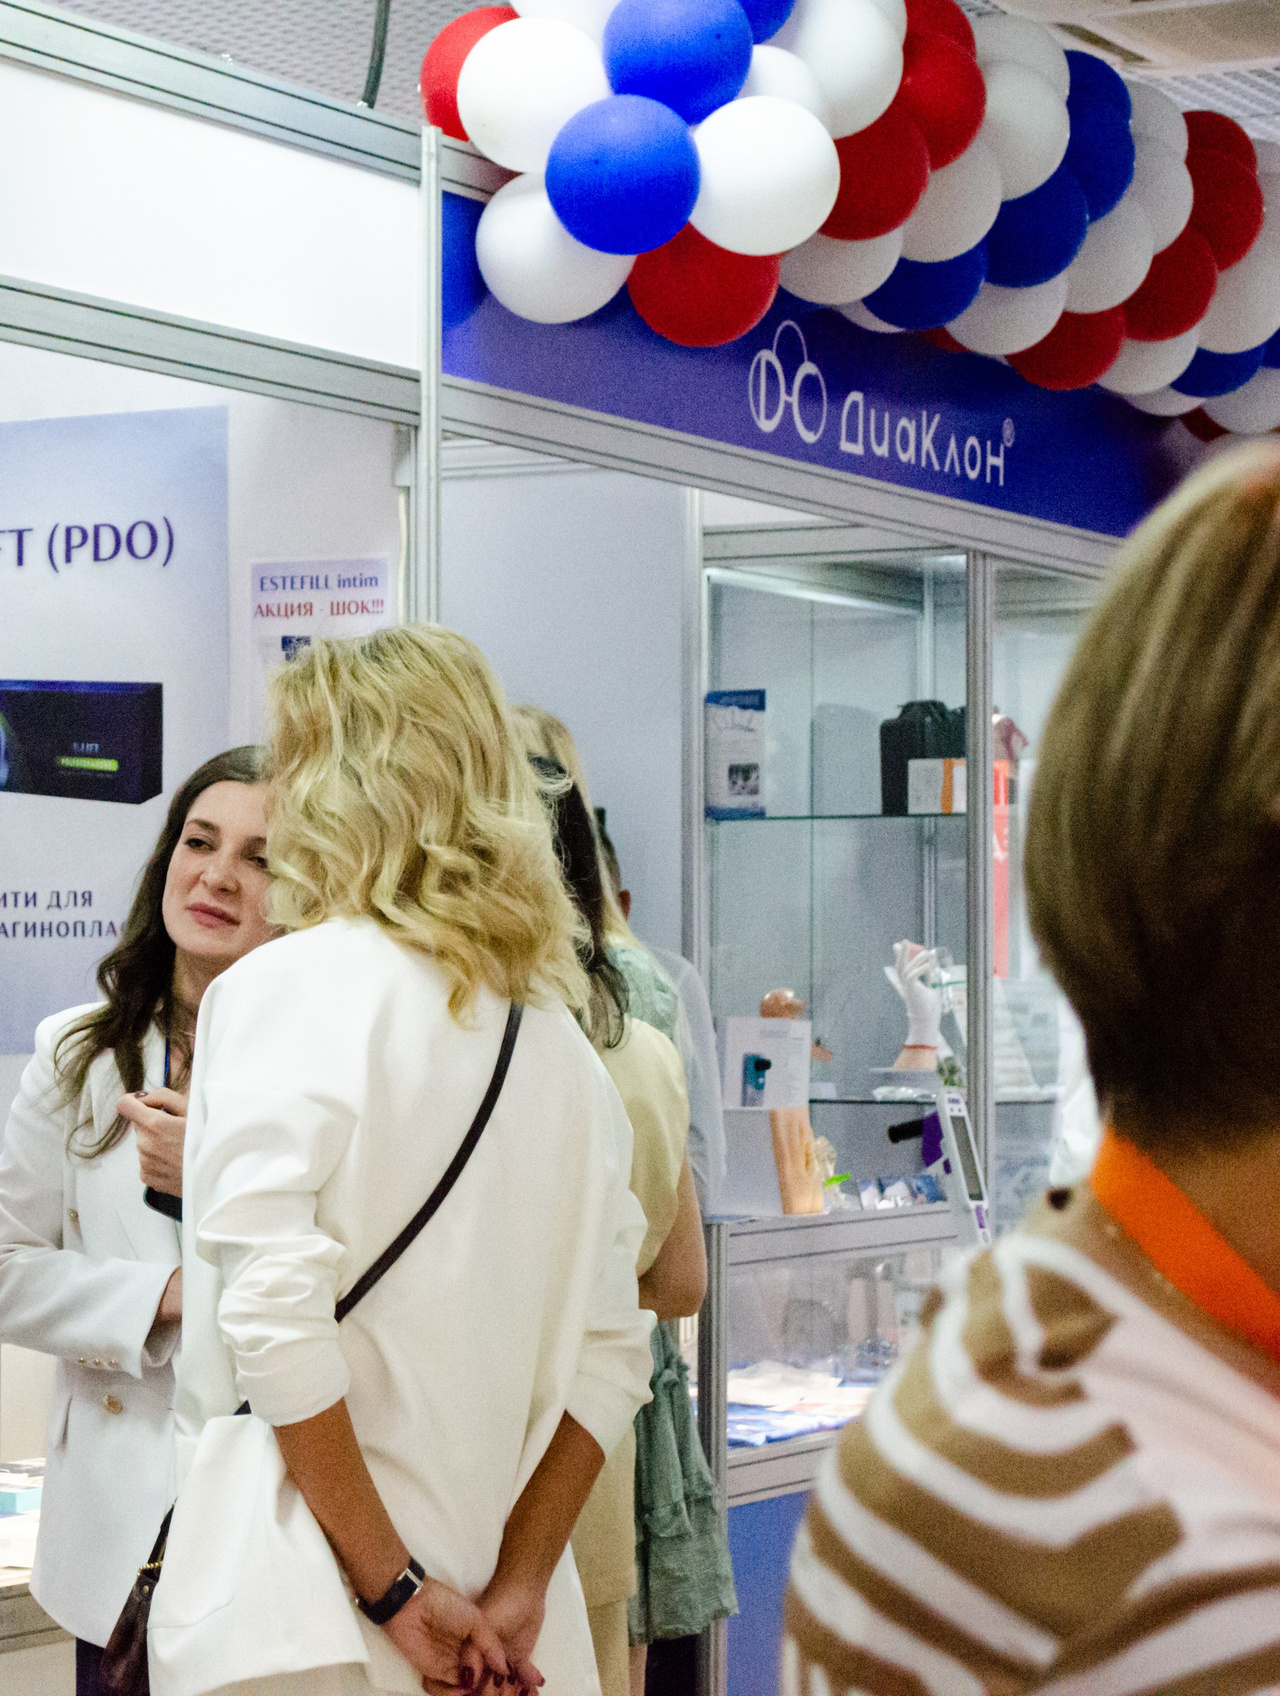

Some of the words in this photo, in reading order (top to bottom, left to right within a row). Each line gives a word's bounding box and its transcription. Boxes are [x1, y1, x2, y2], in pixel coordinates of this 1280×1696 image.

[48, 516, 174, 574] (PDO)
[260, 573, 332, 591] ESTEFILL
[337, 572, 379, 589] intim
[254, 601, 314, 620] АКЦИЯ
[330, 599, 385, 617] ШОК!!!
[47, 889, 92, 911] ДЛЯ
